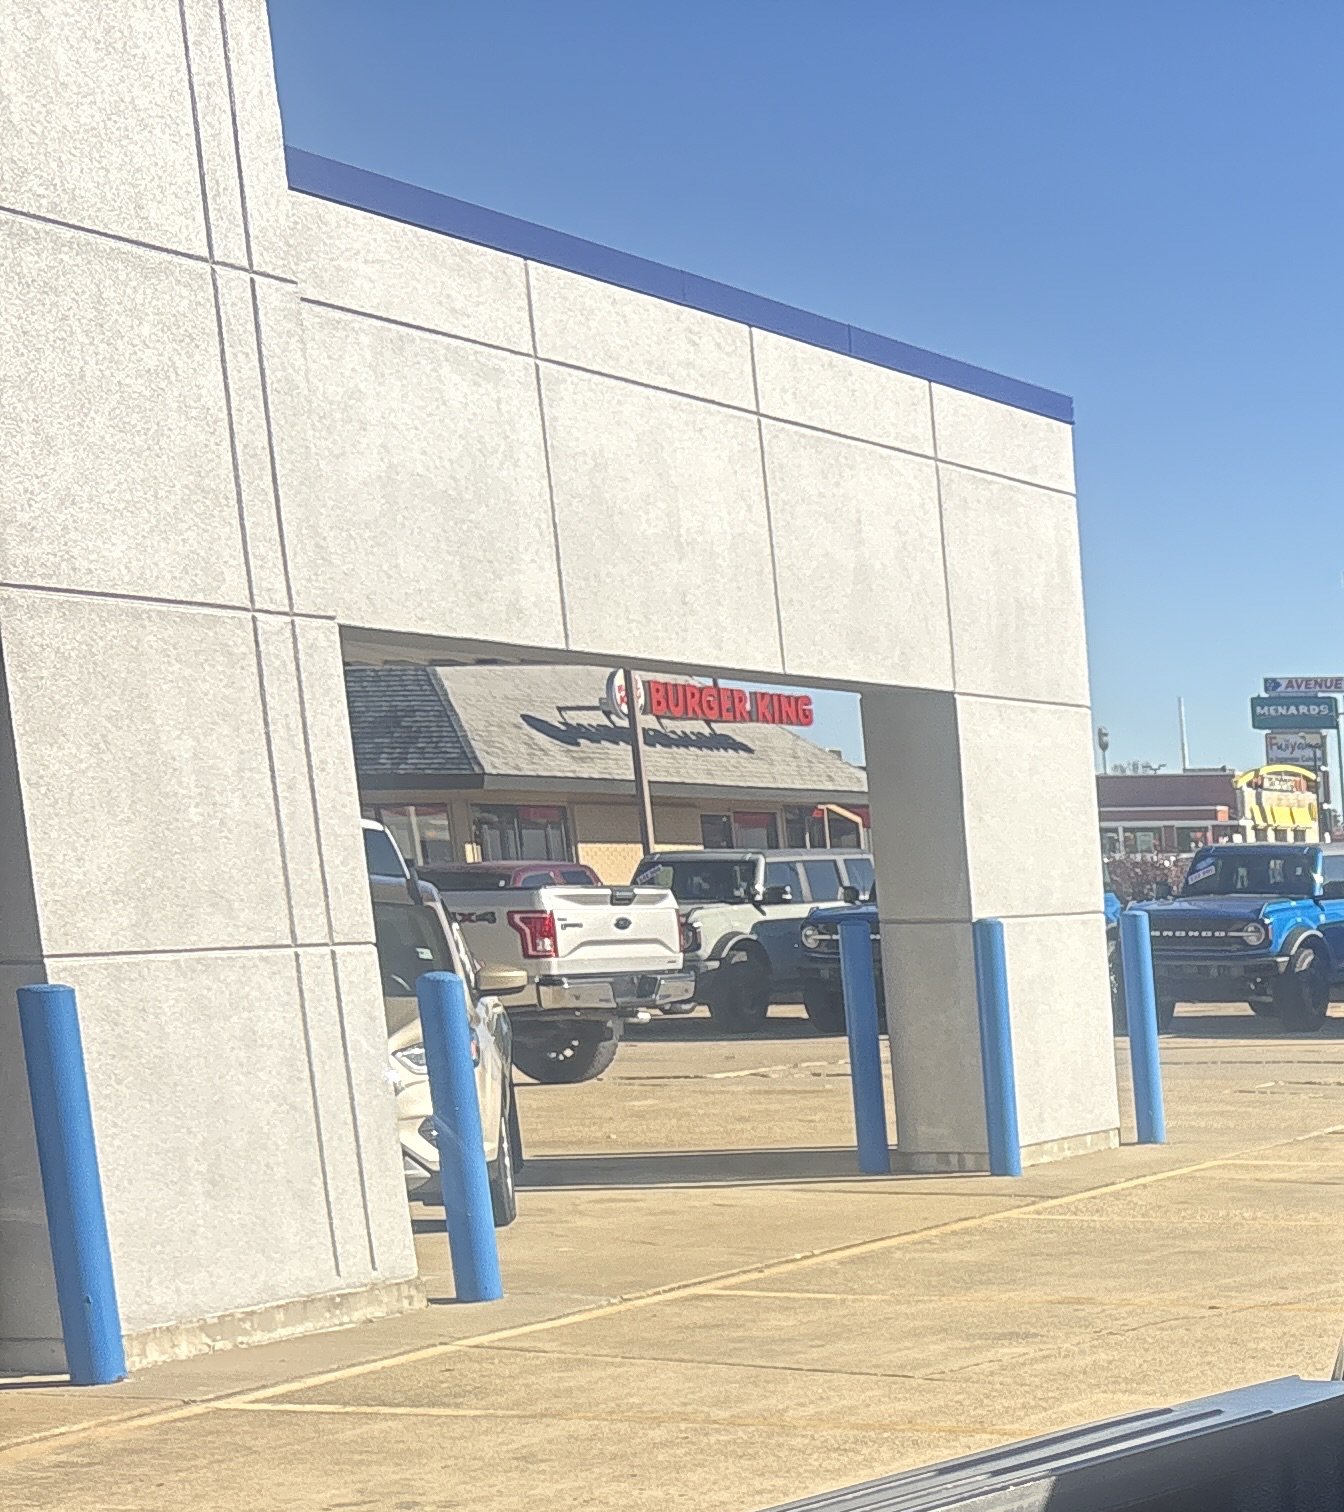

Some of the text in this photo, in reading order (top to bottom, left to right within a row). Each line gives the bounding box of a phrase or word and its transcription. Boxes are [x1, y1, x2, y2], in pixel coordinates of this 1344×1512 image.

[1284, 677, 1343, 690] AVENUE
[650, 680, 750, 722] BURGER
[755, 690, 815, 727] KING
[1255, 705, 1329, 716] MENARDS
